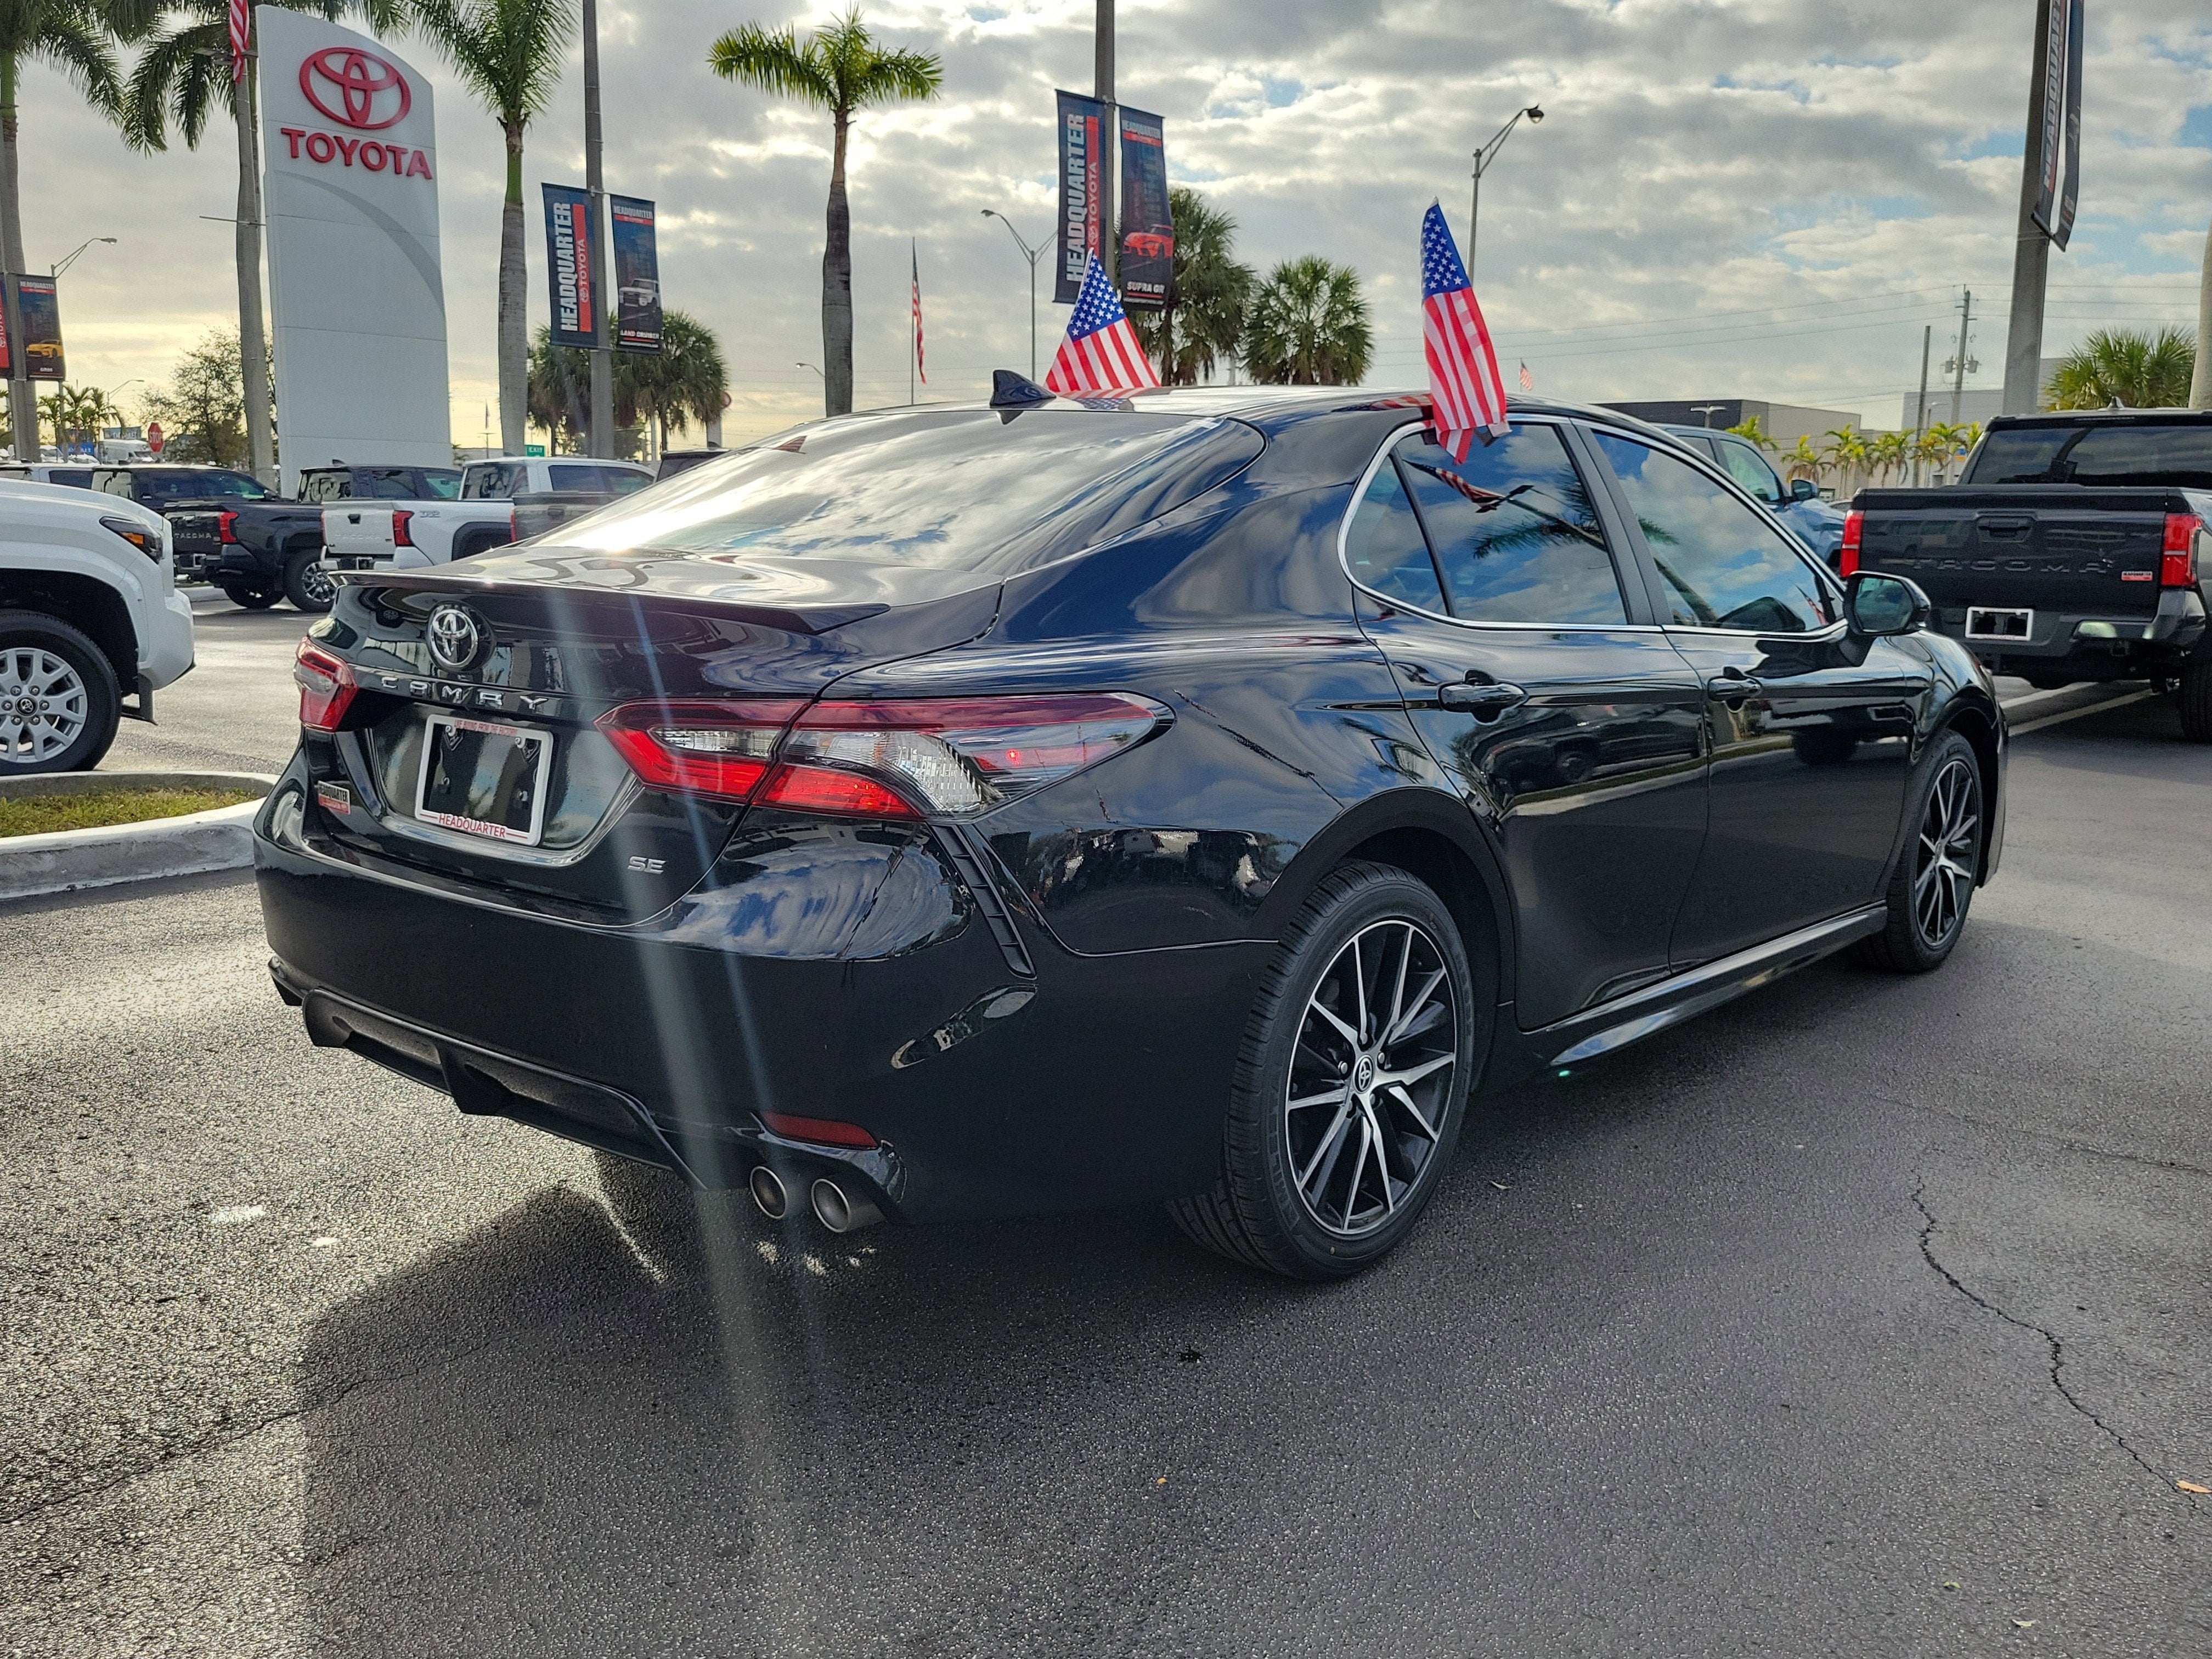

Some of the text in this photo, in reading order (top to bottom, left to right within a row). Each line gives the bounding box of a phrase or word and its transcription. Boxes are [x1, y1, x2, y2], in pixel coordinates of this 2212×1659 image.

[2044, 0, 2062, 189] HEADQUAR
[280, 127, 432, 180] TOYOTA
[1066, 114, 1087, 281] HEADQUARTER
[1088, 162, 1097, 224] TOYOTA
[554, 202, 578, 331] HEADQUARTER
[578, 239, 588, 286] TOYOTA
[1127, 281, 1165, 294] SUPRA GR
[149, 431, 163, 444] STOP
[381, 676, 548, 709] CAMRY
[439, 813, 506, 838] HEADQUARTER
[627, 856, 667, 874] SE
